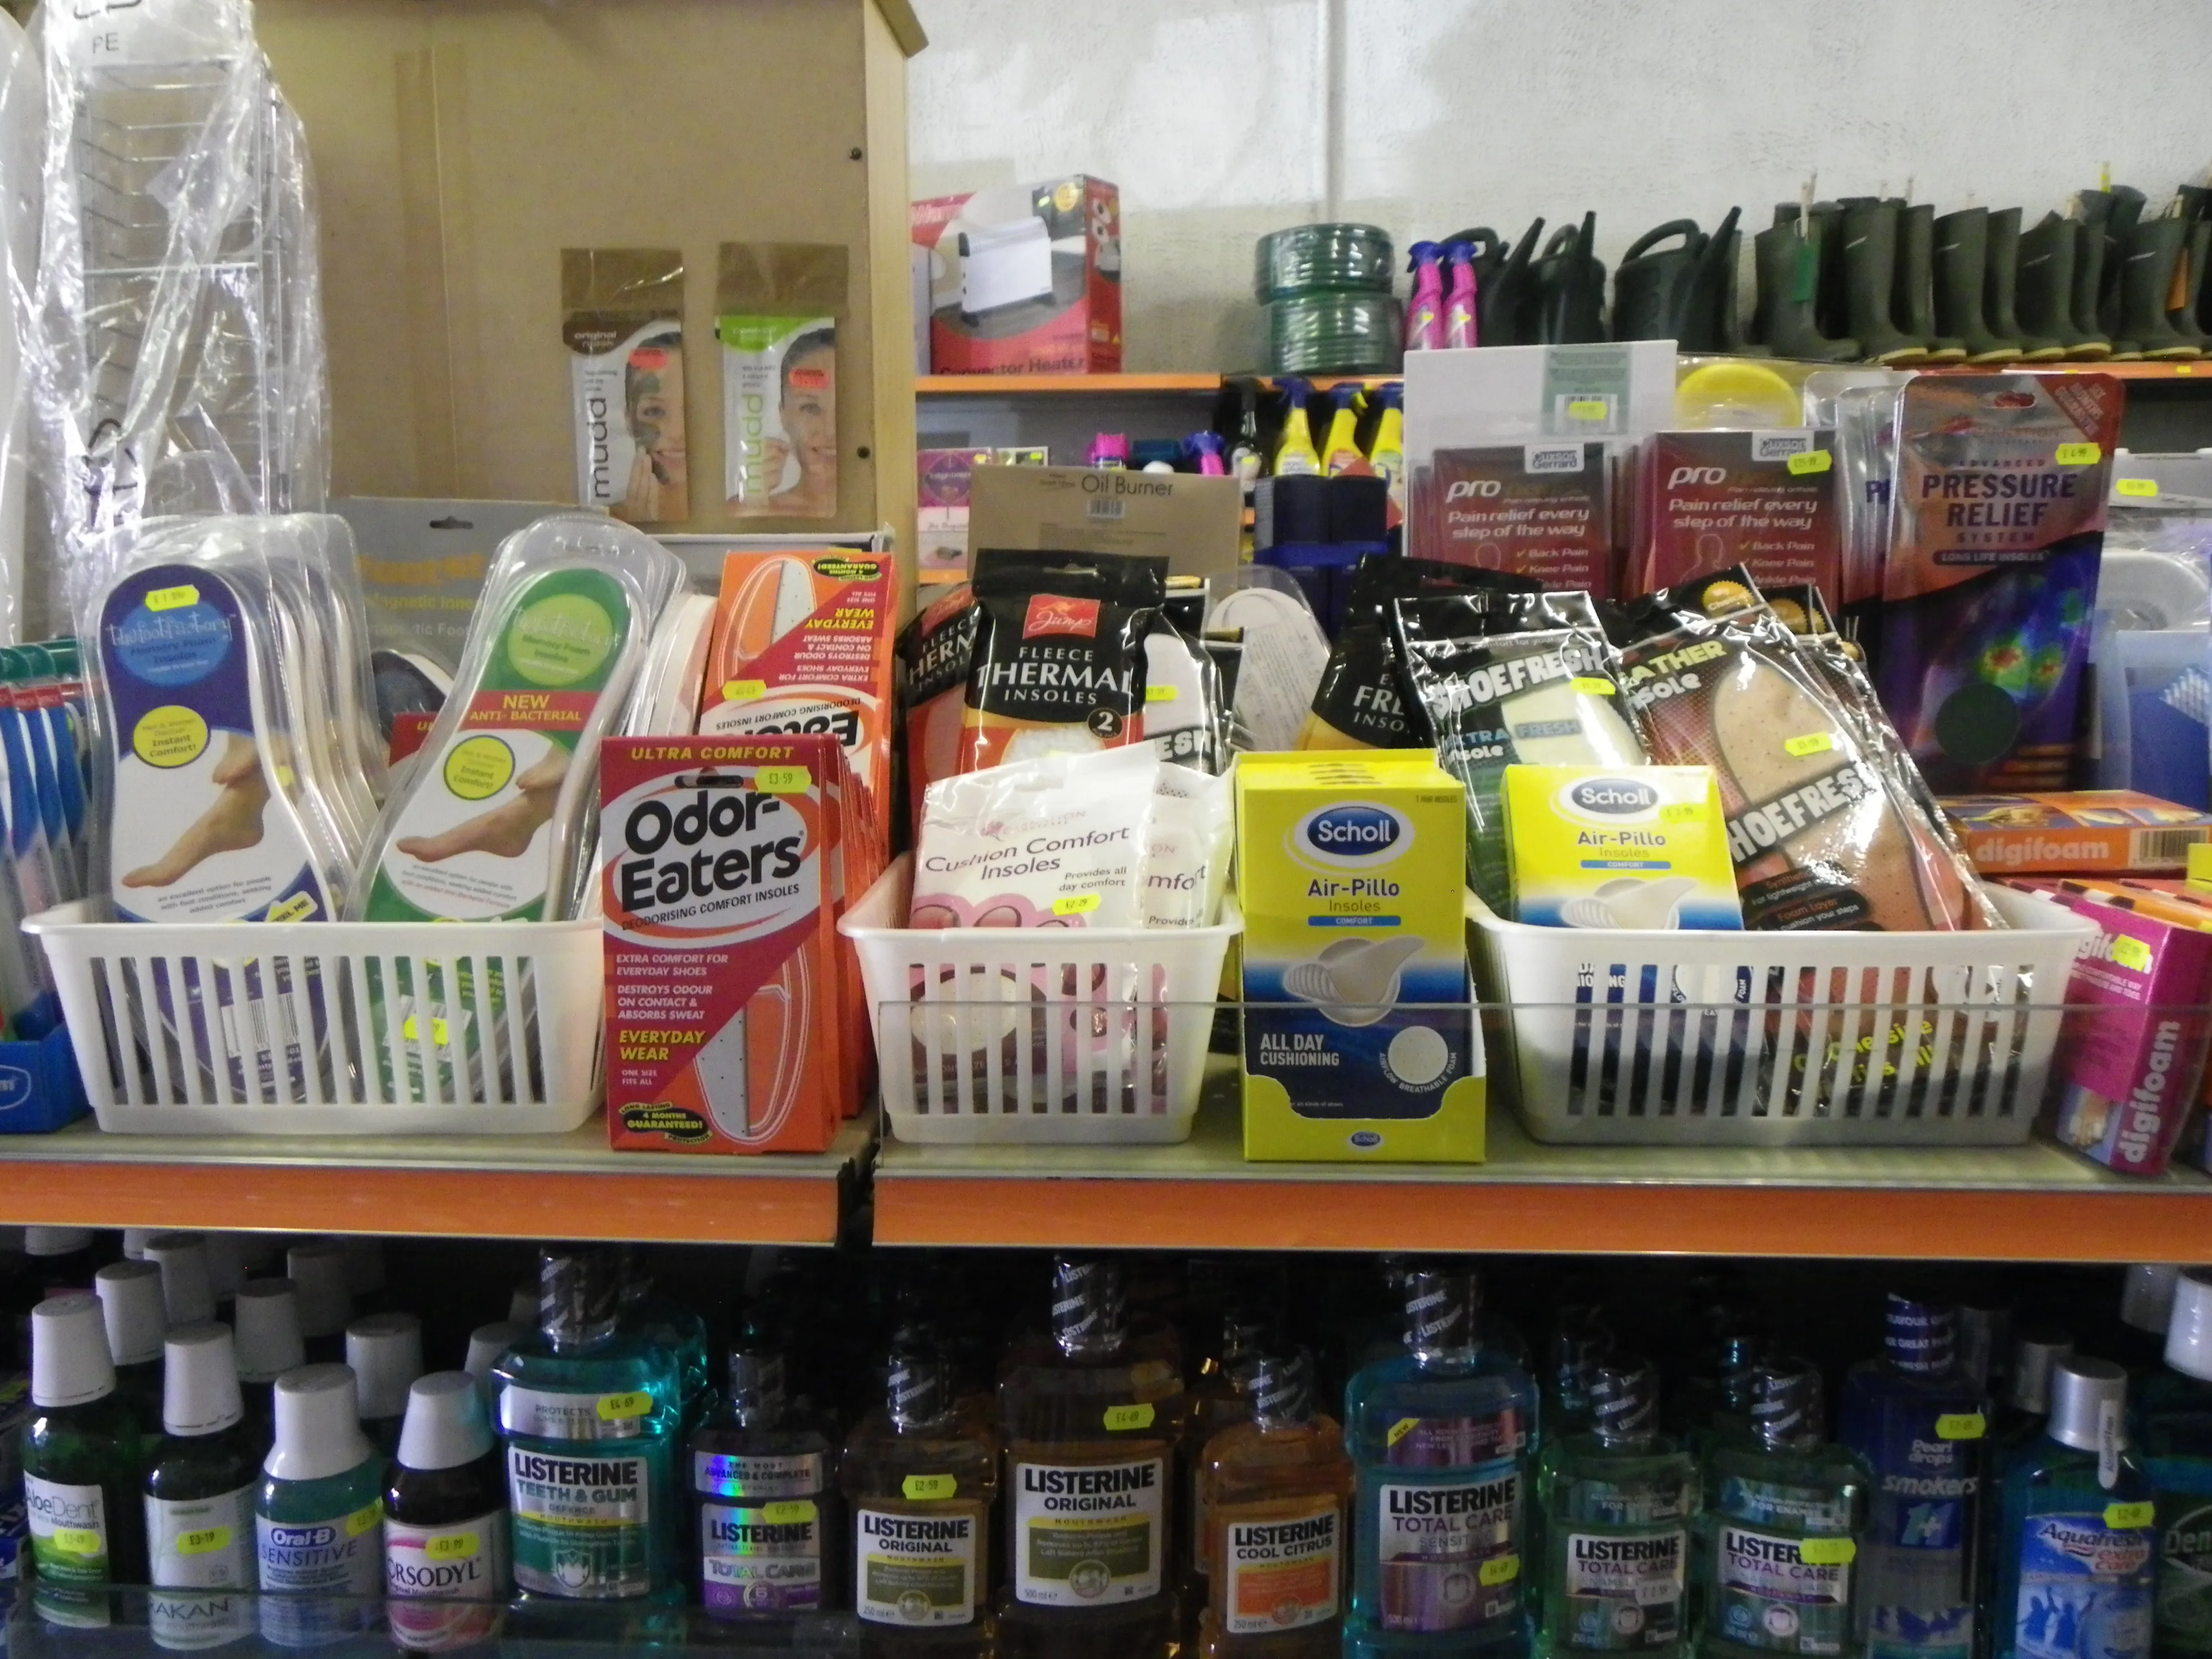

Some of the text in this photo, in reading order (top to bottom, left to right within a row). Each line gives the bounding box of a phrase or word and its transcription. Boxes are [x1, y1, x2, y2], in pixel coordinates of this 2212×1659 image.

[587, 397, 610, 498] mudd
[742, 394, 764, 494] mudd
[1082, 474, 1109, 493] Oil
[1115, 476, 1173, 496] Burner
[1667, 466, 1727, 491] pro
[1922, 473, 2078, 498] PRESSURE
[1445, 480, 1502, 504] pro
[1669, 498, 1818, 514] Pain relief every
[1947, 502, 2048, 526] RELIEF
[1448, 508, 1590, 523] Pain relief every
[1673, 514, 1812, 531] step of the way
[1452, 524, 1585, 539] step of the way
[1528, 547, 1589, 558] Back Pain
[1752, 541, 1815, 551] Back Pain
[1562, 564, 1589, 572] Pain
[1787, 558, 1814, 567] Pain
[834, 608, 874, 618] WEAR
[1028, 610, 1093, 632] Jump
[805, 619, 874, 630] EVERYDAY
[1019, 646, 1094, 662] FLEECE
[977, 662, 1134, 697] THERMAL
[1428, 646, 1604, 720] SHOEFRESH
[503, 695, 550, 709] NEW
[1004, 688, 1098, 705] INSOLES
[799, 698, 861, 714] DEODORISING
[510, 711, 581, 721] BACTERIAL
[716, 709, 797, 731] INSOLES COMFORT
[1098, 712, 1113, 731] 2
[1517, 721, 1580, 737] FRESH
[152, 734, 191, 748] Instant
[149, 743, 197, 758] Comfort!
[631, 746, 795, 760] ULTRA COMFORT
[460, 765, 494, 780] Instant
[453, 775, 494, 790] Comfort!
[1580, 786, 1651, 807] Scholl
[625, 790, 780, 855] Odor-
[1317, 819, 1391, 843] Scholl
[1577, 831, 1666, 847] Air-Pillo
[925, 827, 1131, 874] Cushion Comfort
[1599, 847, 1651, 858] Insoles
[1975, 836, 2110, 867] digifoam
[621, 836, 801, 912] Eaters
[980, 857, 1061, 881] Insoles
[1064, 866, 1127, 881] Provides all
[1058, 878, 1126, 893] day comfort
[1308, 878, 1401, 897] Air-Pillo
[622, 884, 800, 931] DEODORISING COMFORT INSOLES
[1329, 899, 1381, 912] Insoles
[616, 954, 729, 963] EXTRA COMFORT FOR
[616, 967, 708, 976] EVERYDAY SHOES
[617, 985, 713, 995] DESTROYS ODOUR
[617, 997, 698, 1007] ON CONTACT &
[618, 1010, 706, 1020] ABSORBS SWEAT
[619, 1030, 707, 1044] EVERYDAY
[1260, 1033, 1325, 1051] ALL DAY
[620, 1047, 670, 1061] WEAR
[1260, 1052, 1340, 1067] CUSHIONING
[1398, 1052, 1457, 1094] BREATHABLE FOAM
[2118, 1020, 2180, 1163] digifoam
[627, 1119, 703, 1129] GUARANTEED!
[1353, 1134, 1378, 1144] Scholl
[535, 1405, 591, 1416] PROTECTS
[1393, 1422, 1410, 1438] NEW
[514, 1452, 639, 1486] LISTERINE
[1024, 1464, 1156, 1495] LISTERINE
[1881, 1475, 1980, 1494] smokers
[517, 1479, 637, 1504] TEETH & GUM
[1389, 1478, 1516, 1515] LISTERINE
[1044, 1494, 1137, 1511] ORIGINAL
[1392, 1504, 1514, 1533] TOTAL CARE
[711, 1519, 812, 1543] LISTERINE
[864, 1515, 971, 1541] LISTERINE
[1234, 1513, 1334, 1547] LISTERINE
[272, 1528, 331, 1546] Oral-B
[878, 1538, 953, 1553] ORIGINAL
[261, 1539, 358, 1567] SENSITIVE
[1236, 1535, 1333, 1560] COOL CITRUS
[1575, 1535, 1680, 1561] LISTERINE
[1578, 1557, 1678, 1576] TOTAL CARE
[1727, 1552, 1839, 1581] TOTAL CARE
